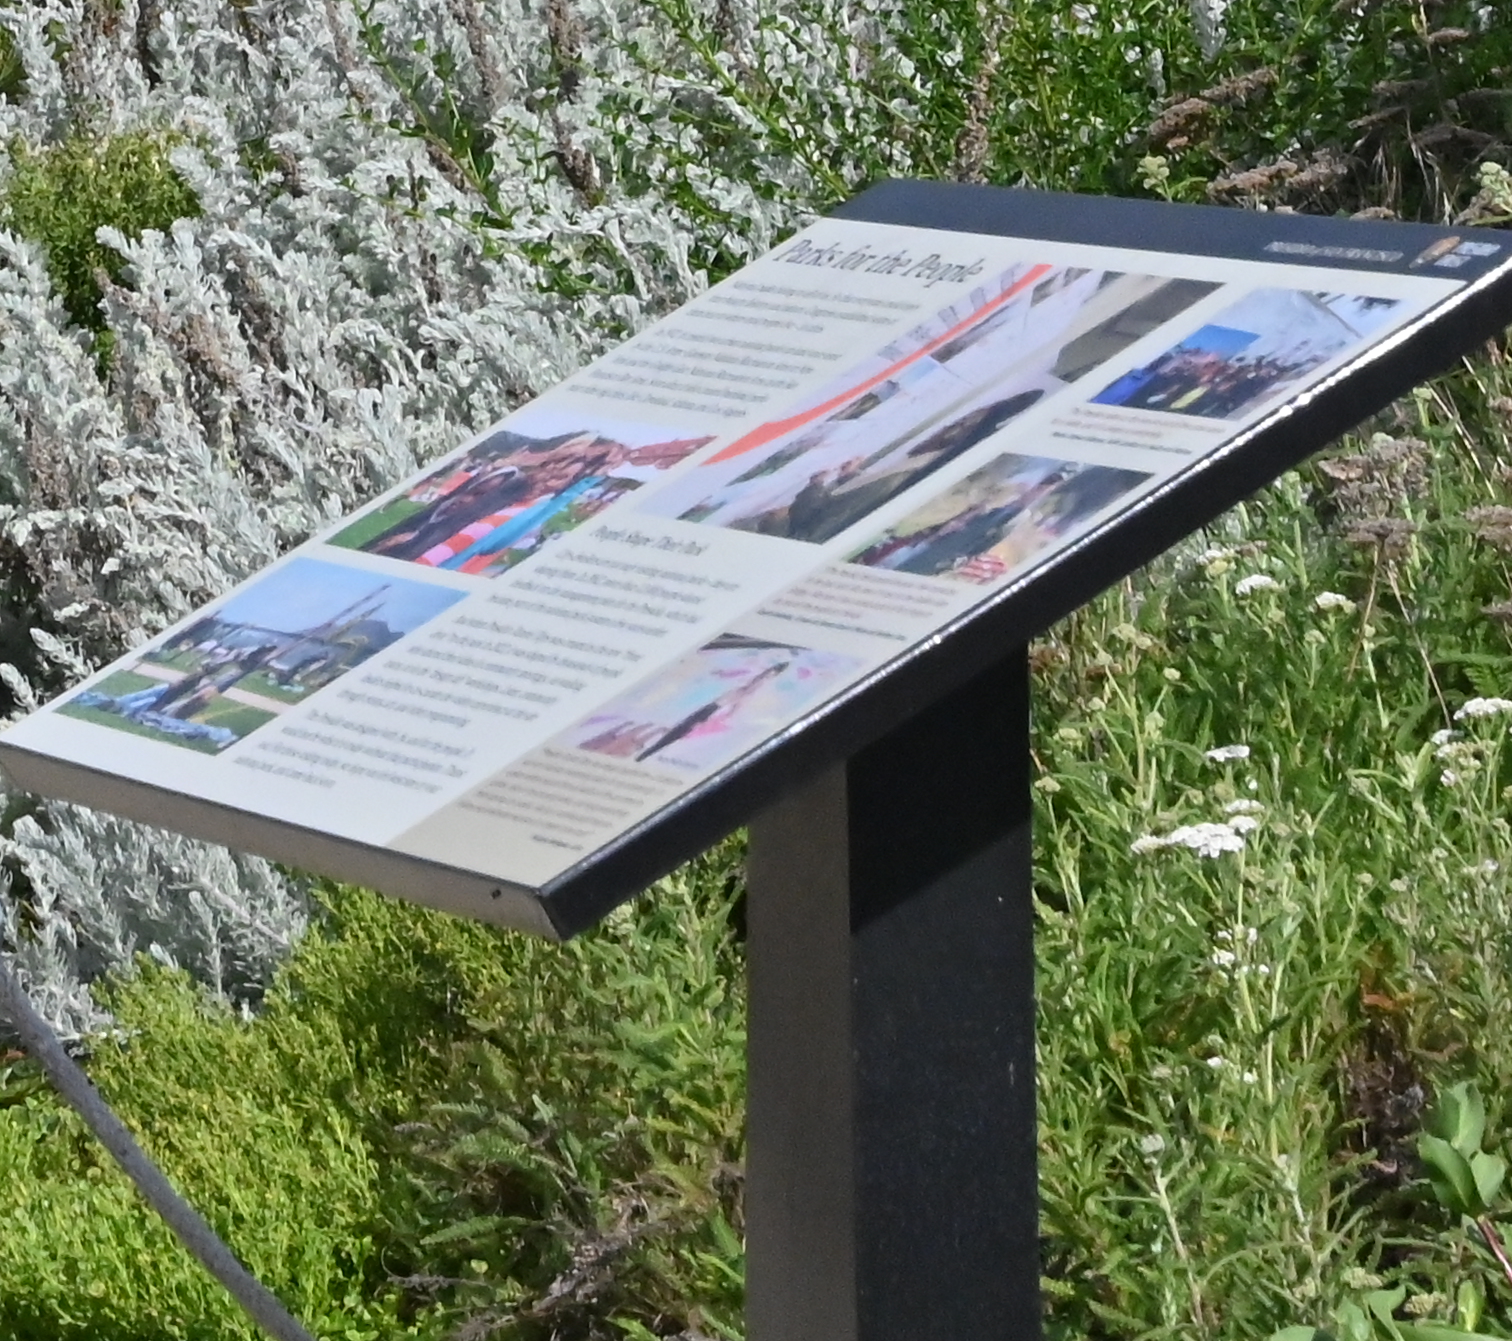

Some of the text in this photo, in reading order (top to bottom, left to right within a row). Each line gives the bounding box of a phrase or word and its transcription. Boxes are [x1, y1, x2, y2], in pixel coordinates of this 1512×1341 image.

[773, 239, 985, 288] Parks for the People
